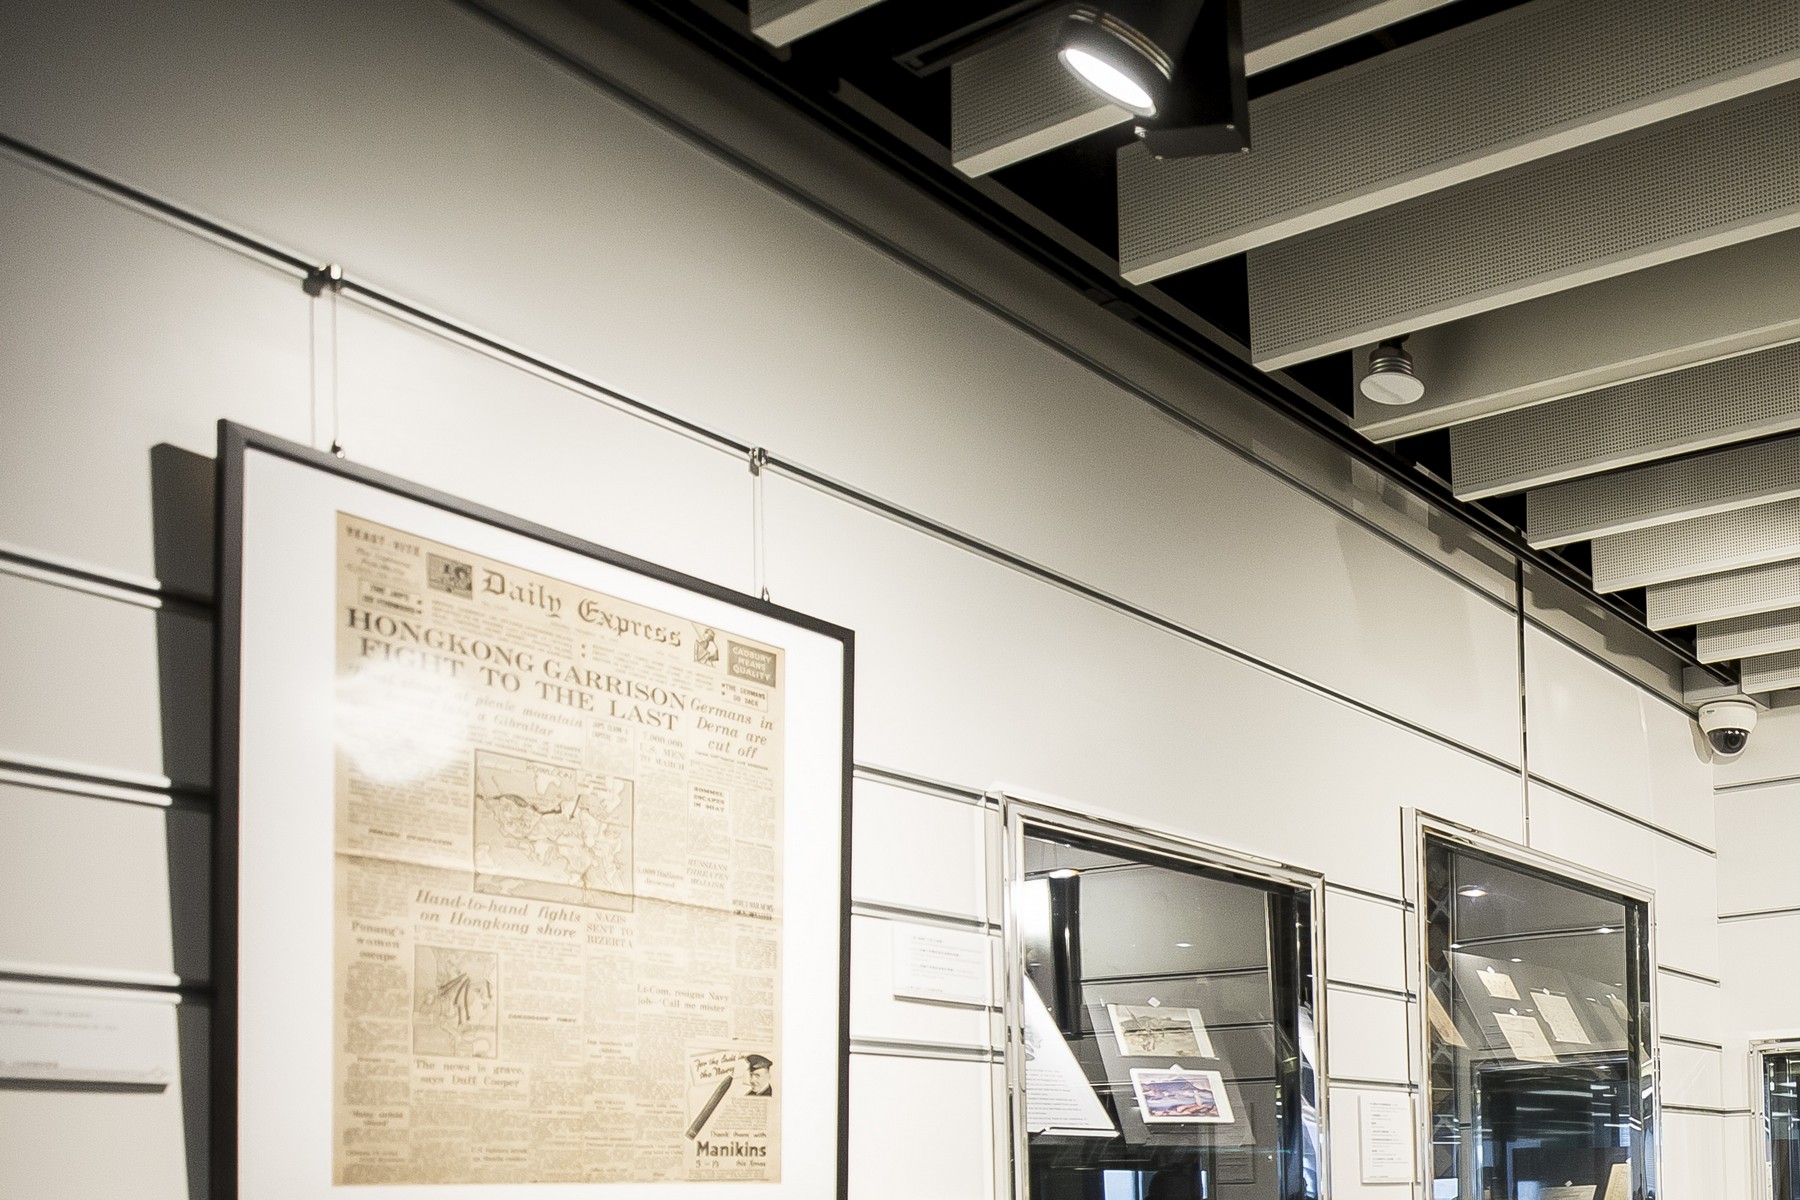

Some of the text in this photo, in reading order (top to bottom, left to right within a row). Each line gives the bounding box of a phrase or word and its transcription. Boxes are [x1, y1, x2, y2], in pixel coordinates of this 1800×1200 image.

[482, 567, 562, 618] Daily
[578, 598, 682, 647] Express
[347, 607, 536, 673] HONGKONG
[543, 658, 687, 711] GARRISON
[732, 645, 772, 664] CADBURY
[737, 656, 766, 673] MEANS
[732, 664, 771, 681] QUALITY
[360, 636, 679, 732] FIGHT TO THE LAST
[523, 706, 583, 729] mountain
[691, 697, 774, 731] Germans in
[494, 715, 554, 736] Gibraltar
[697, 716, 768, 746] Derna are
[708, 739, 758, 760] cut off
[415, 889, 581, 923] Hand-to-hand fights
[419, 911, 577, 938] on Hongkong shore
[594, 913, 626, 924] NAZIS
[586, 924, 633, 936] SENT TO
[709, 991, 730, 1002] Navy
[415, 1059, 435, 1070] The
[443, 1063, 470, 1072] news
[477, 1062, 487, 1073] is
[420, 1074, 520, 1089] says Duff Cooper
[696, 1140, 767, 1158] Manikins
